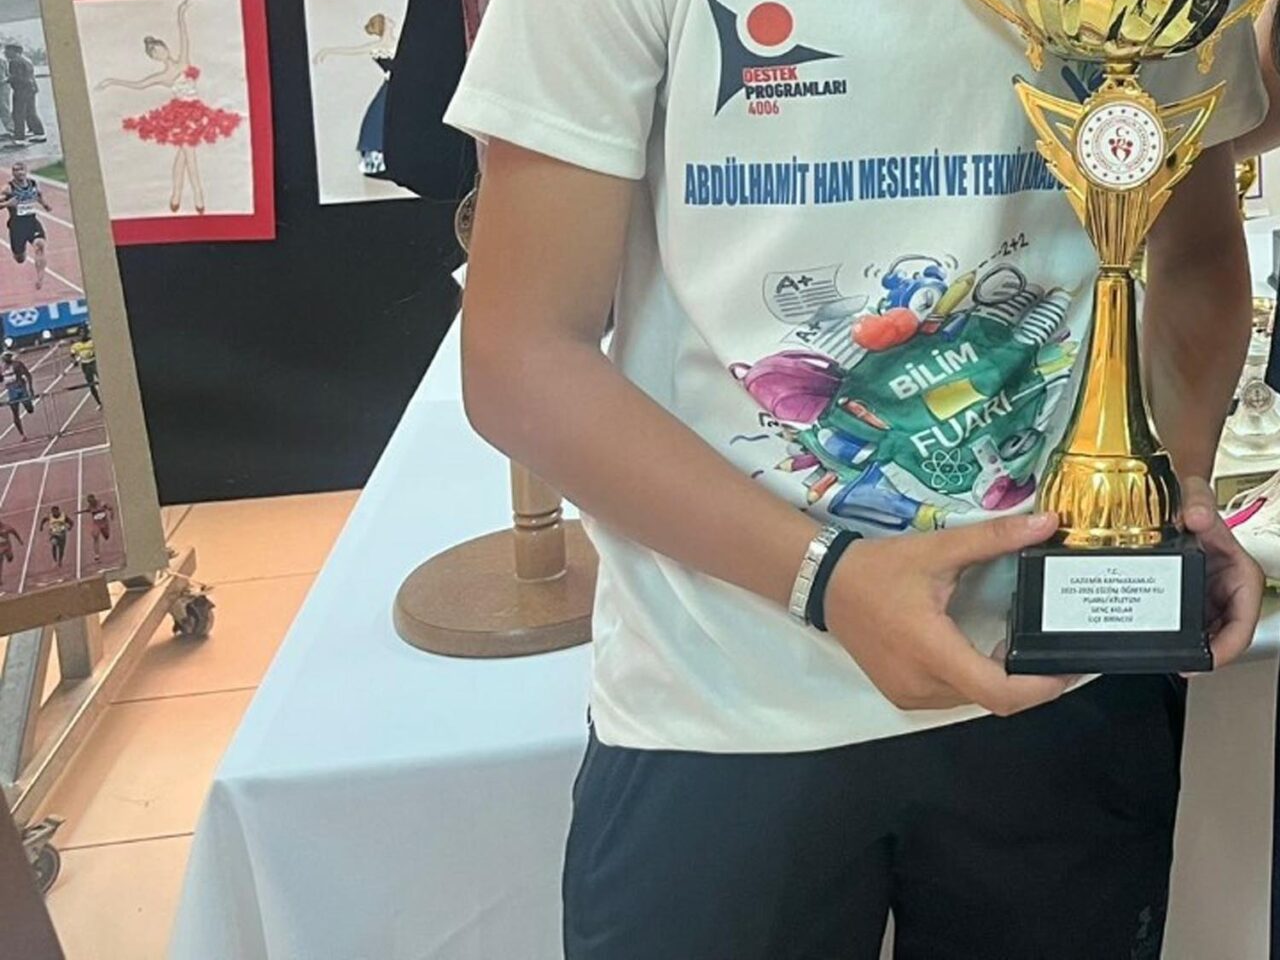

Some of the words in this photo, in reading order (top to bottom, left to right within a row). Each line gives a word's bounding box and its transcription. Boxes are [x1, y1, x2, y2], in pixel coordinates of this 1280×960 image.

[743, 67, 798, 84] DESTEK
[745, 79, 848, 100] PROGRAMLARI
[748, 100, 780, 115] 4006
[684, 155, 810, 206] ABDÜLHAMİT
[813, 158, 855, 204] HAN
[858, 147, 941, 200] MESLEKİ
[943, 155, 969, 197] VE
[775, 274, 815, 294] A+
[888, 341, 980, 401] BİLİM
[909, 391, 1013, 458] FUARI
